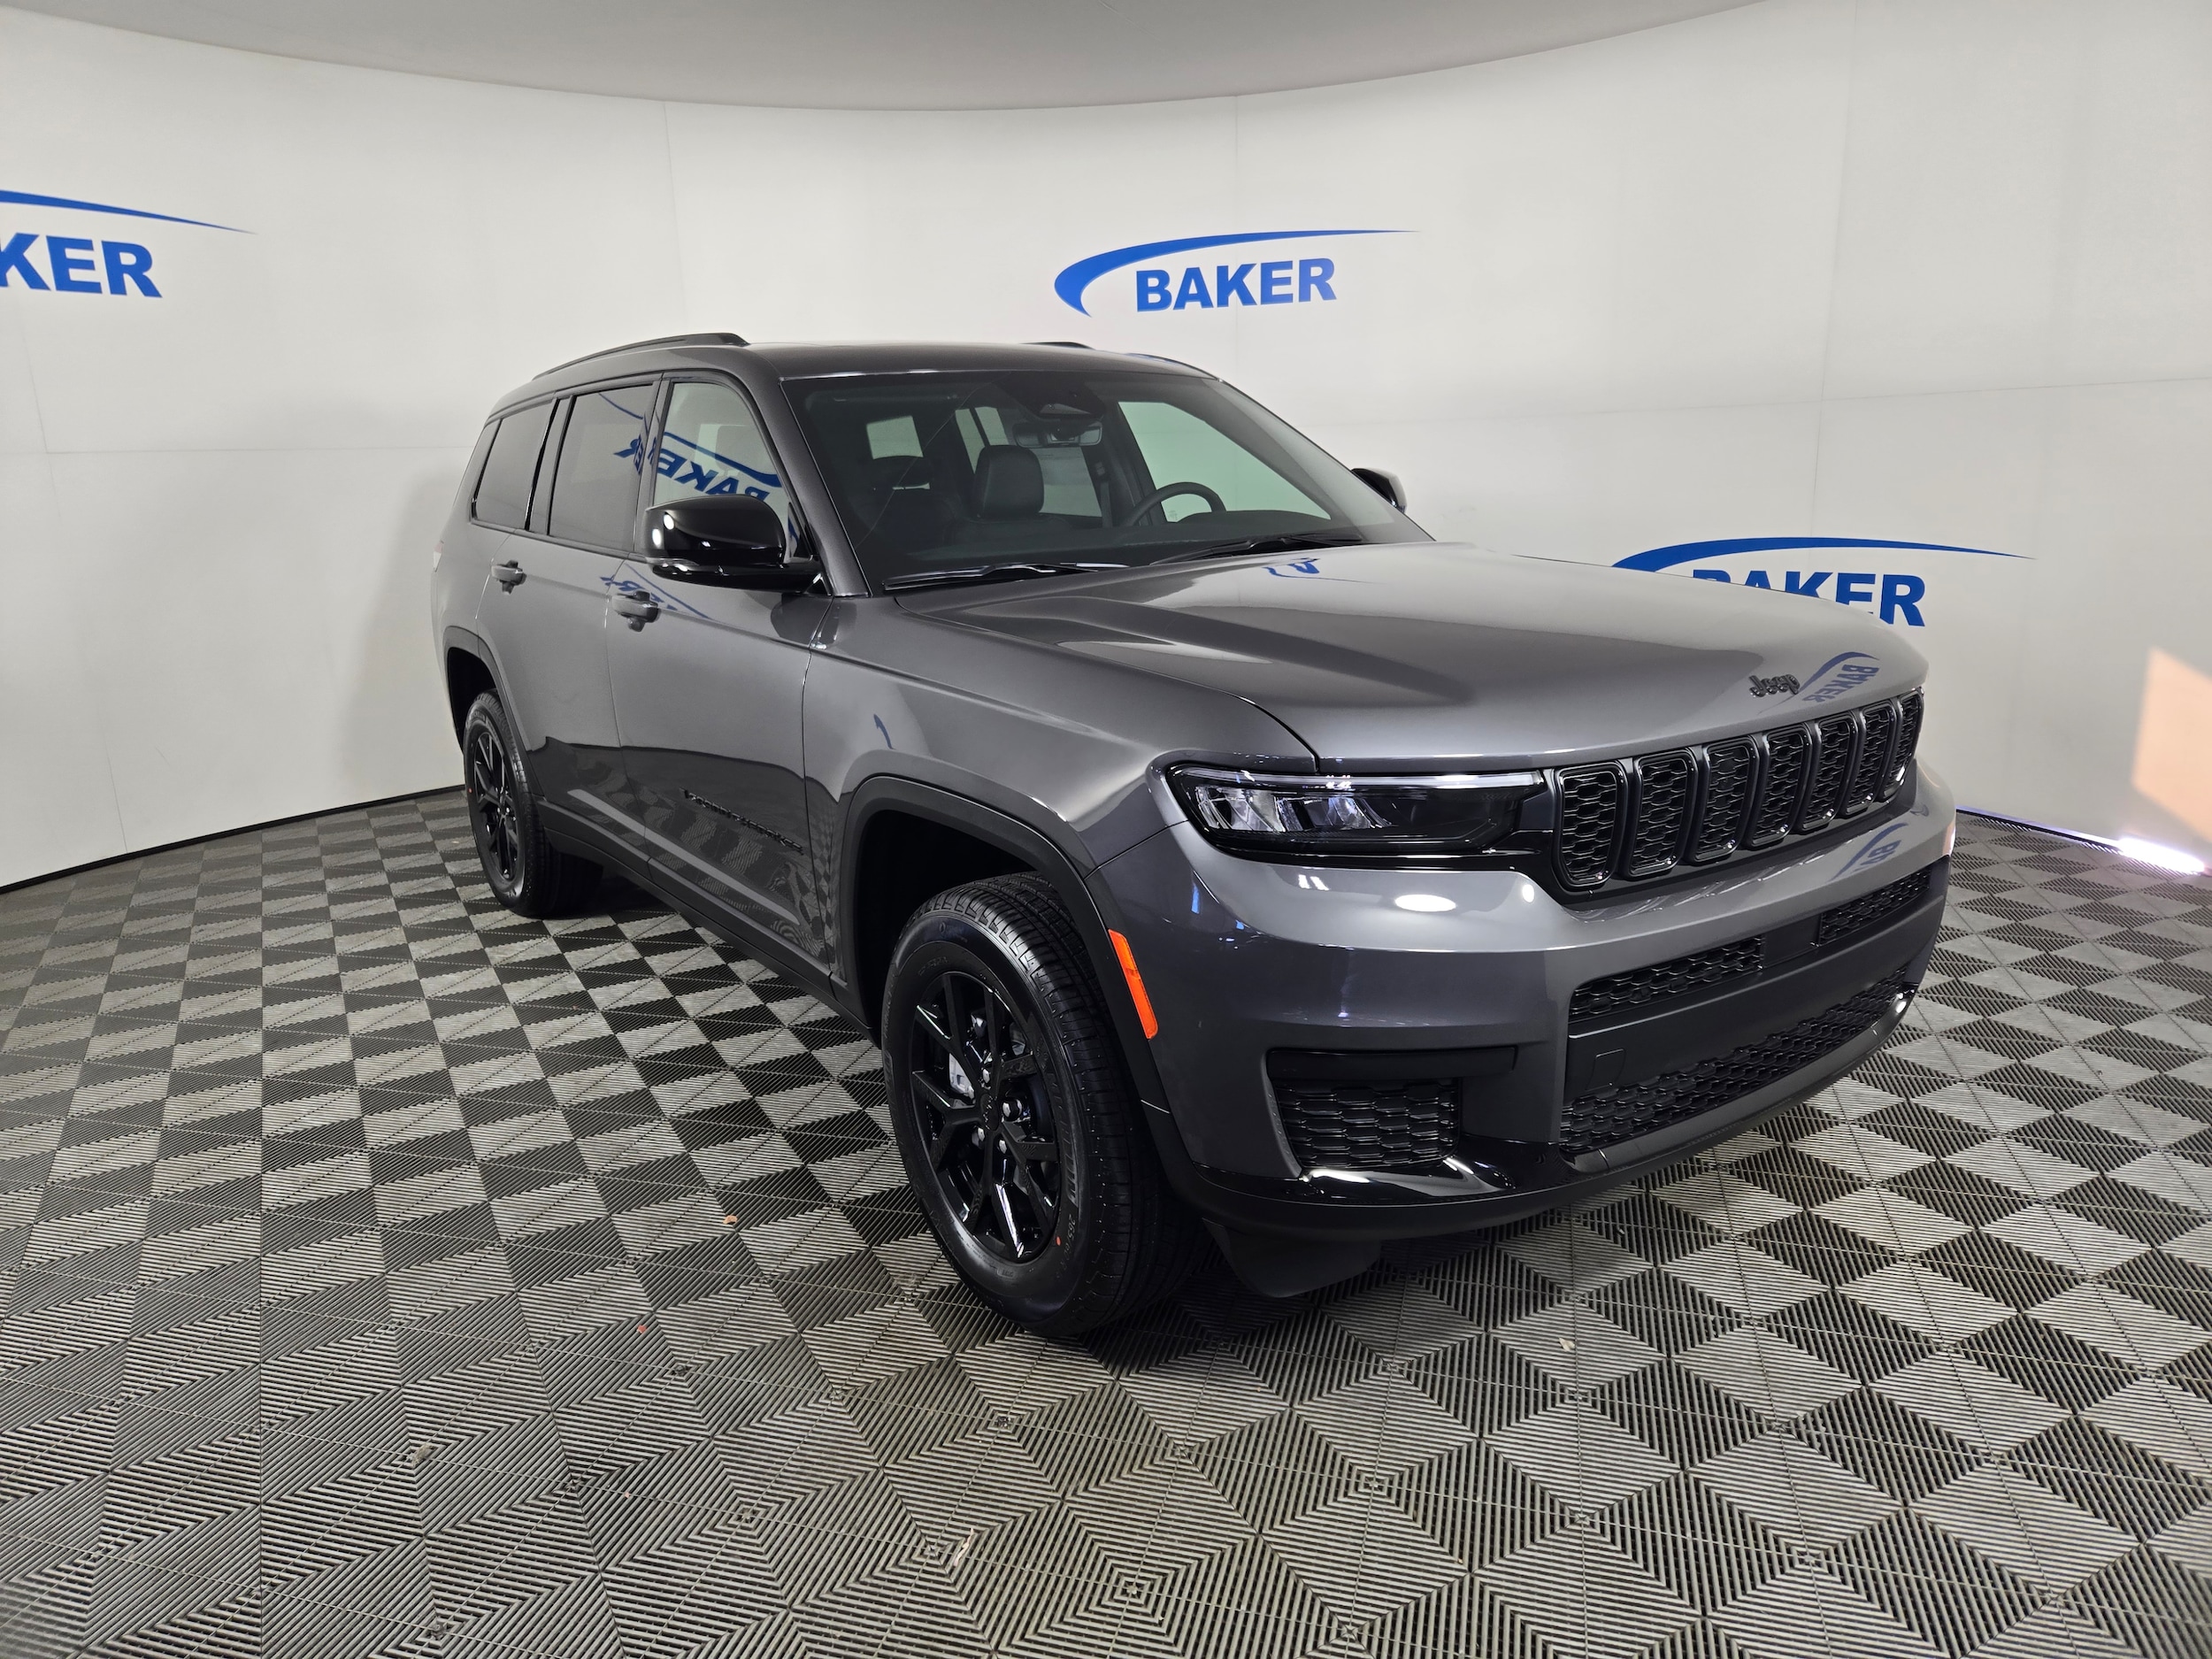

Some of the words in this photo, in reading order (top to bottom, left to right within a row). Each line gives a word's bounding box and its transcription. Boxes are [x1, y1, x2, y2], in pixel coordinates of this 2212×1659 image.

[0, 232, 163, 298] KER
[1136, 257, 1337, 312] BAKER
[1748, 673, 1801, 697] Jeep
